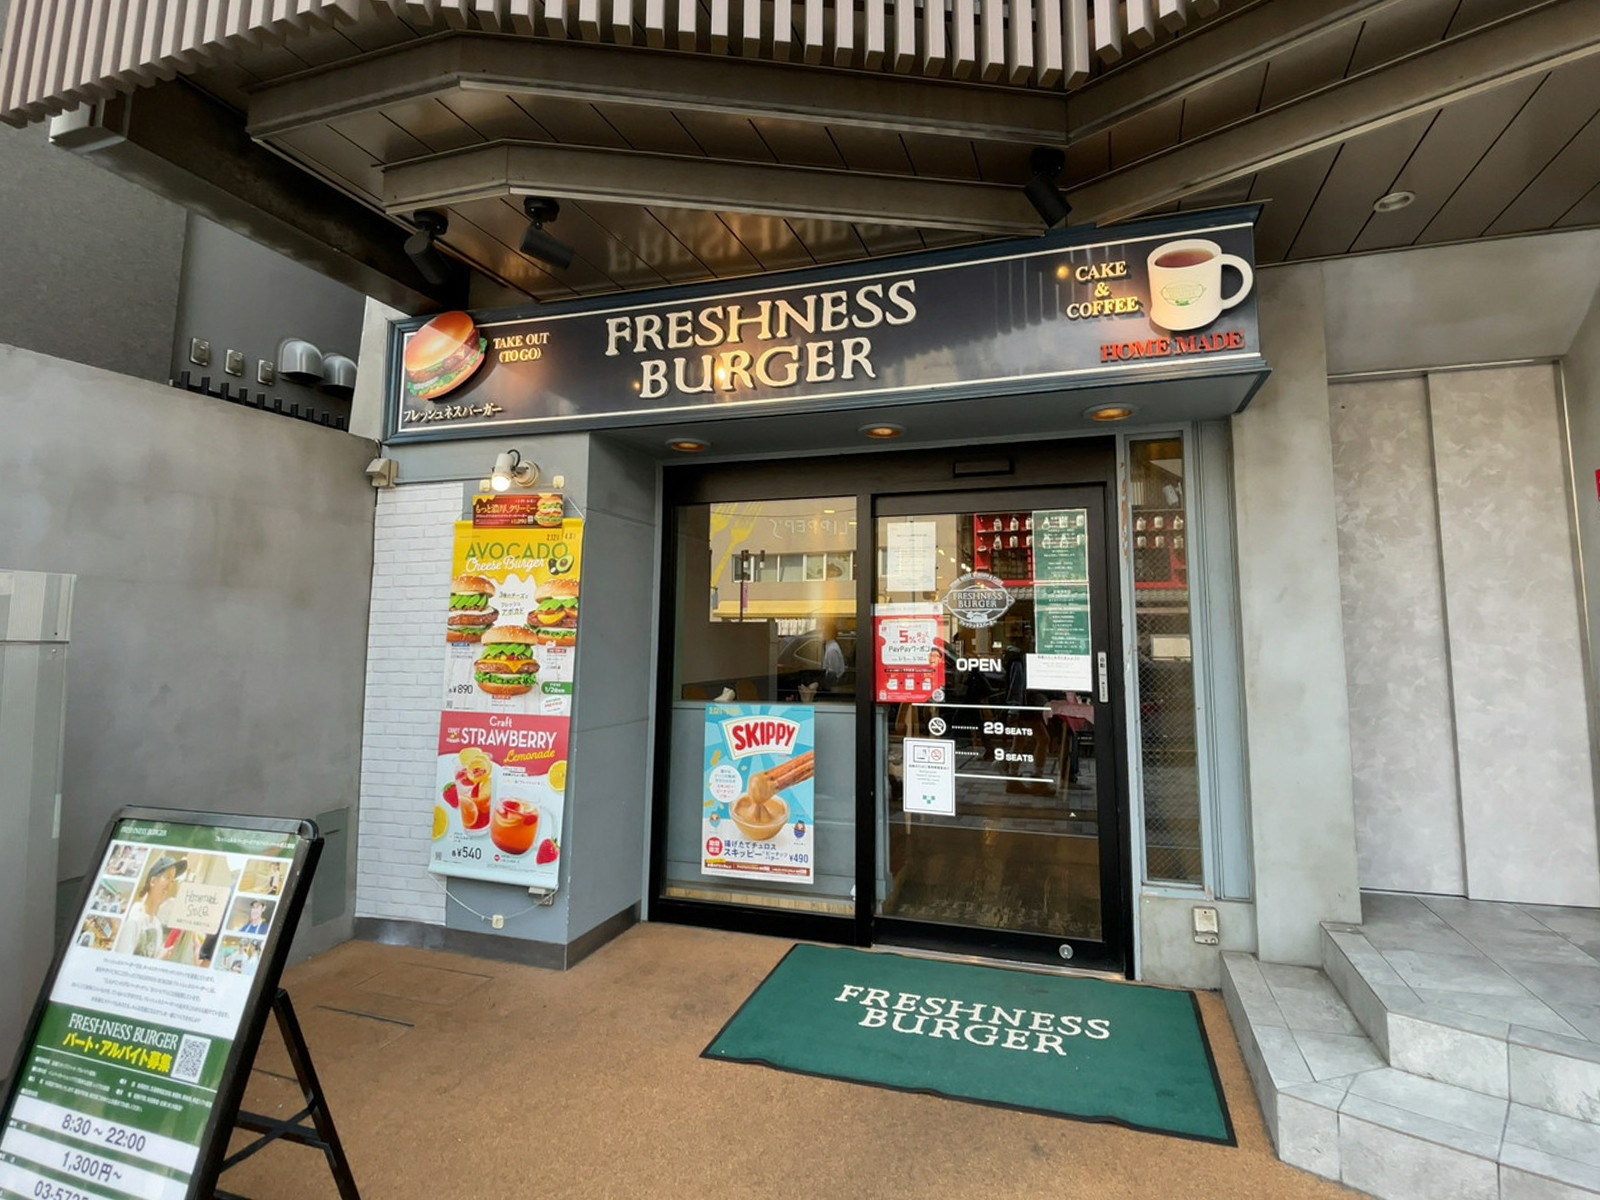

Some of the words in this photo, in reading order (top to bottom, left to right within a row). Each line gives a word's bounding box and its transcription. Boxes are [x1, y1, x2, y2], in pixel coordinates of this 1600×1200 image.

[1075, 260, 1127, 281] CAKE
[1094, 282, 1110, 297] &
[1066, 296, 1140, 319] COFFEE
[604, 279, 918, 357] FRESHNESS
[493, 337, 524, 350] TAKE
[526, 332, 550, 346] OUT
[1100, 336, 1171, 363] HOME
[1174, 330, 1245, 354] MADE
[638, 336, 877, 400] BURGER
[403, 403, 504, 424] フレッシュネスバーガー
[465, 542, 569, 560] AVOCADO
[465, 557, 501, 573] Cheese
[953, 592, 1003, 600] FRESHNESS
[958, 600, 997, 608] BURGER
[956, 658, 1001, 673] OPEN
[489, 716, 513, 728] Craft
[983, 721, 1004, 735] 29
[1004, 726, 1033, 736] SEATS
[460, 727, 558, 749] STRAWBERRY
[732, 721, 796, 751] SKIPPY
[503, 749, 556, 764] Lemonade
[994, 748, 1005, 762] 9
[1005, 753, 1034, 763] SEATS
[723, 848, 763, 859] スキッピー
[834, 984, 1111, 1040] FRESHNESS
[68, 1012, 133, 1041] FRESHNESS
[131, 1026, 179, 1050] BURGER
[858, 1007, 1067, 1056] BURGER
[61, 1113, 91, 1136] 8:30
[104, 1126, 146, 1152] 22:00
